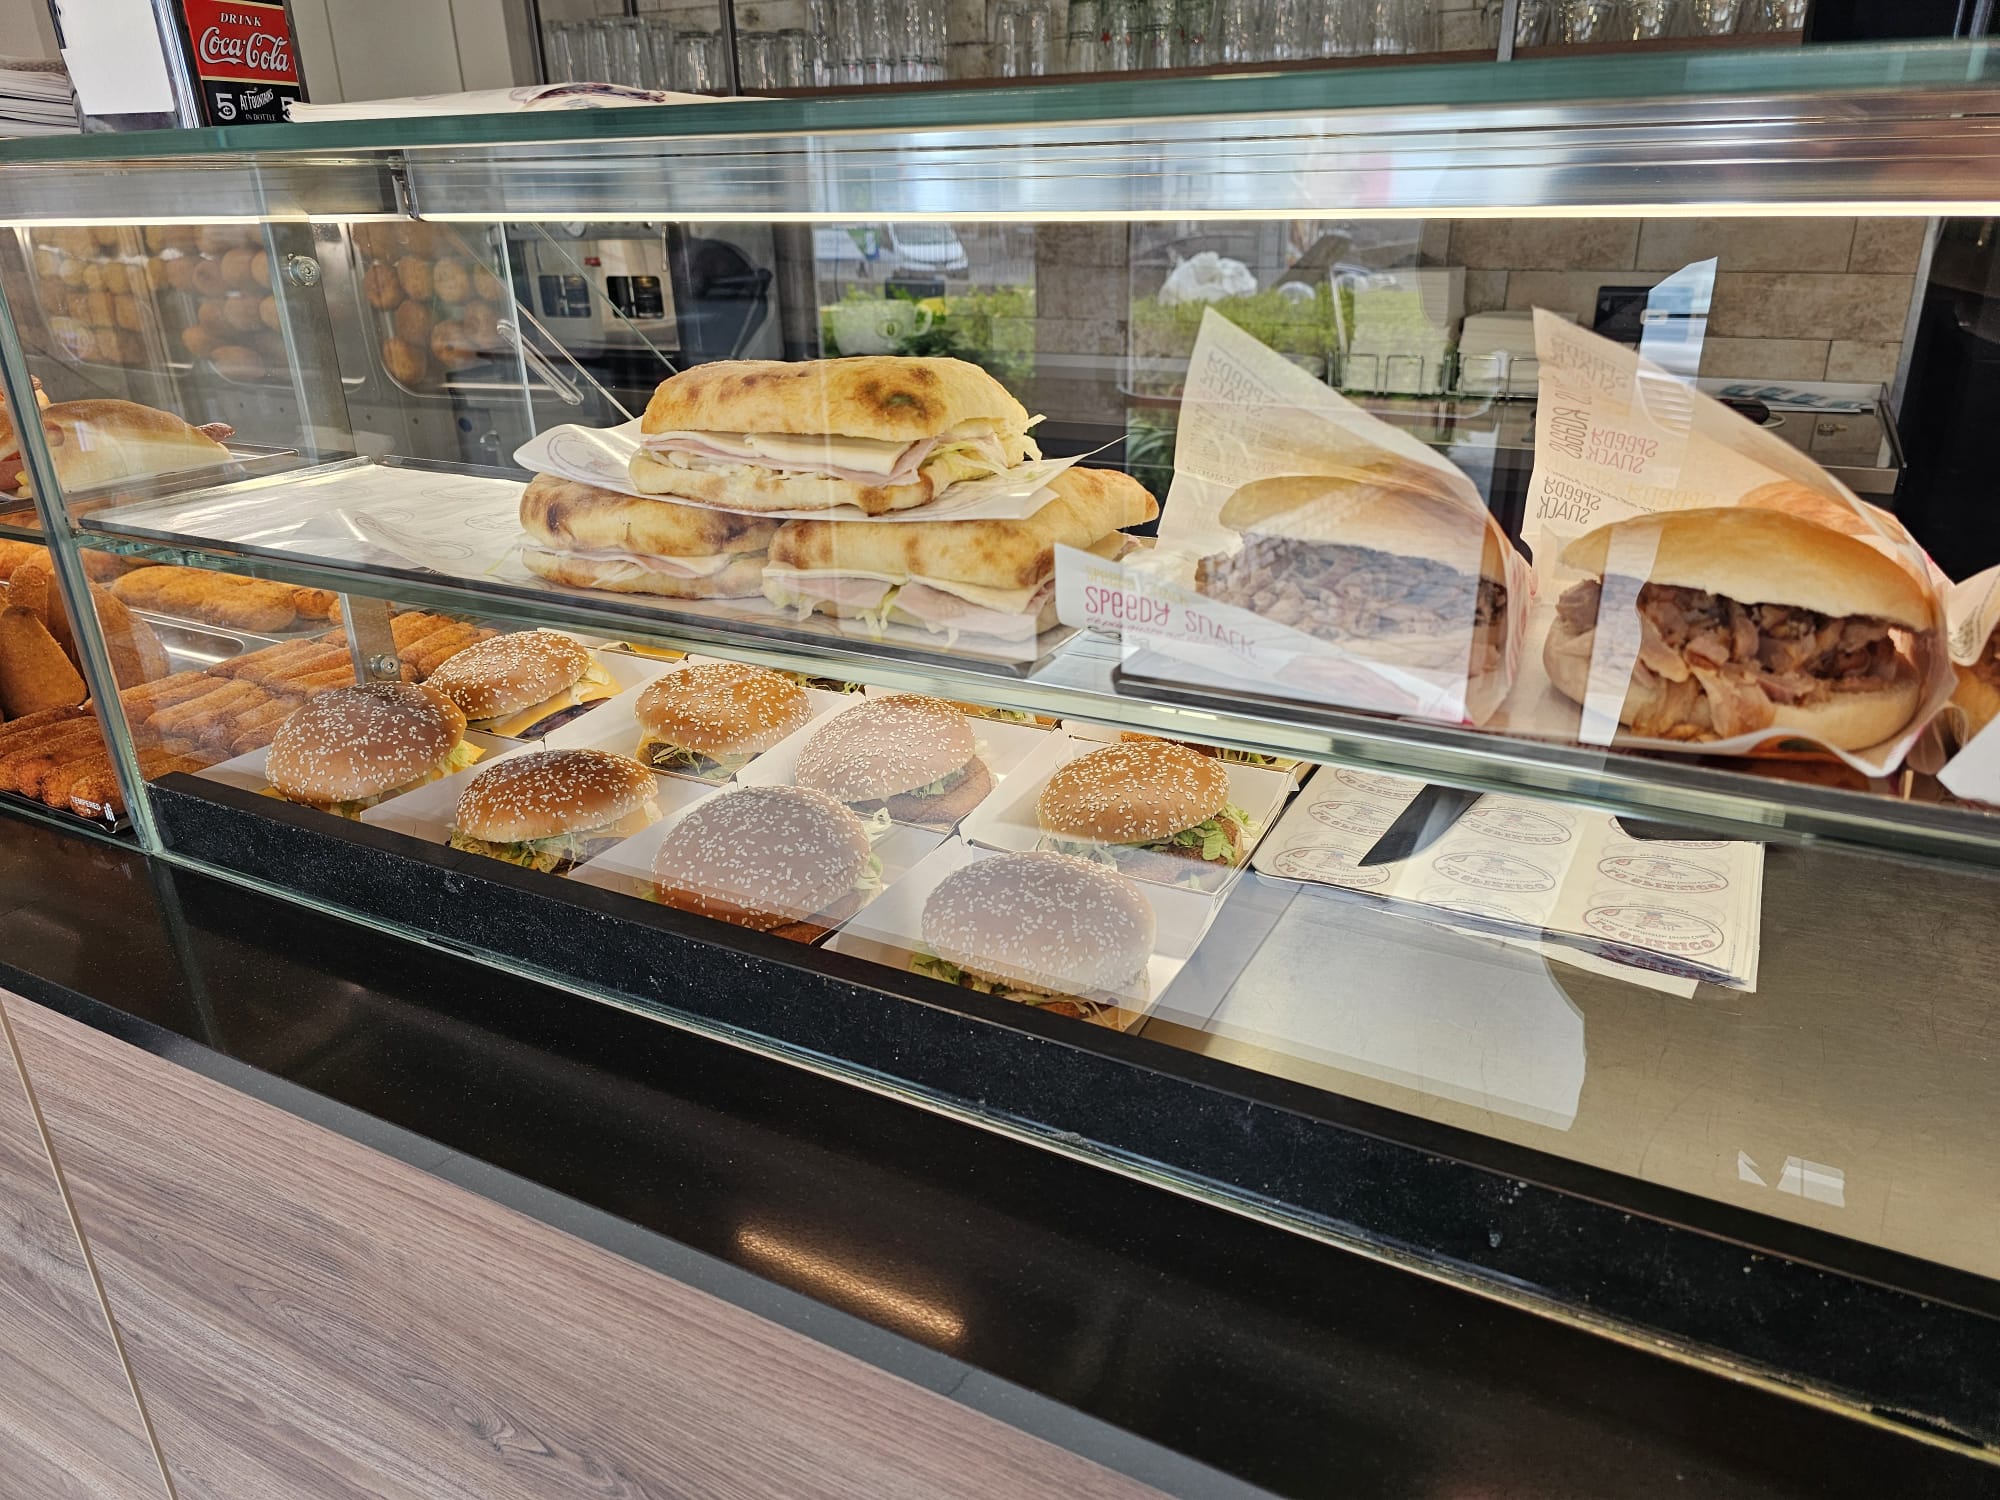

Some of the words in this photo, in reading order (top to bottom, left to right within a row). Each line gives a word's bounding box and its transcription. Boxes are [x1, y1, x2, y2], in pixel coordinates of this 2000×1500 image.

[220, 12, 262, 27] DRINK
[1085, 586, 1170, 626] SPEEDY
[1184, 609, 1257, 659] SNACK
